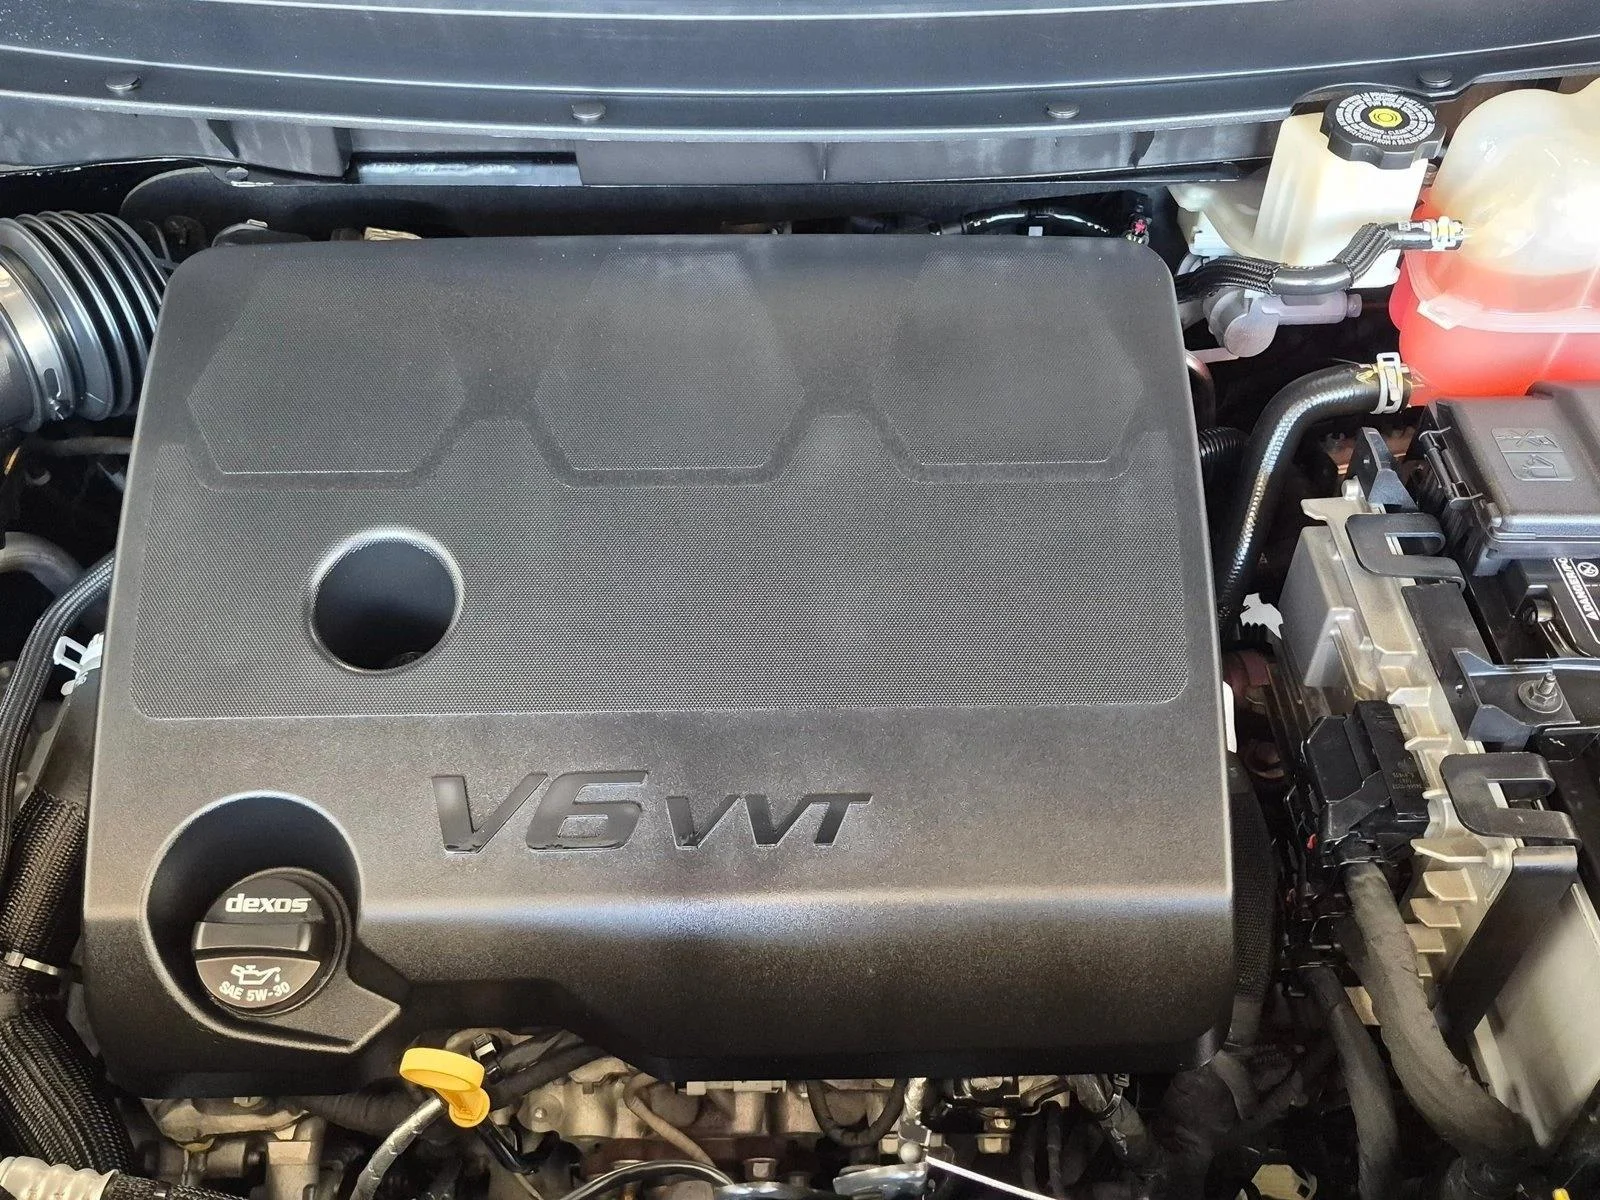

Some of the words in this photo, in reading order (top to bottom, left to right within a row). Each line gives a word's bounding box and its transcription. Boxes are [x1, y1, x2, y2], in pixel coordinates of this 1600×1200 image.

[431, 770, 650, 854] V6
[666, 793, 873, 849] VVT
[225, 893, 312, 913] dexos
[219, 981, 244, 1001] SAE
[247, 981, 290, 1002] 5W-30
